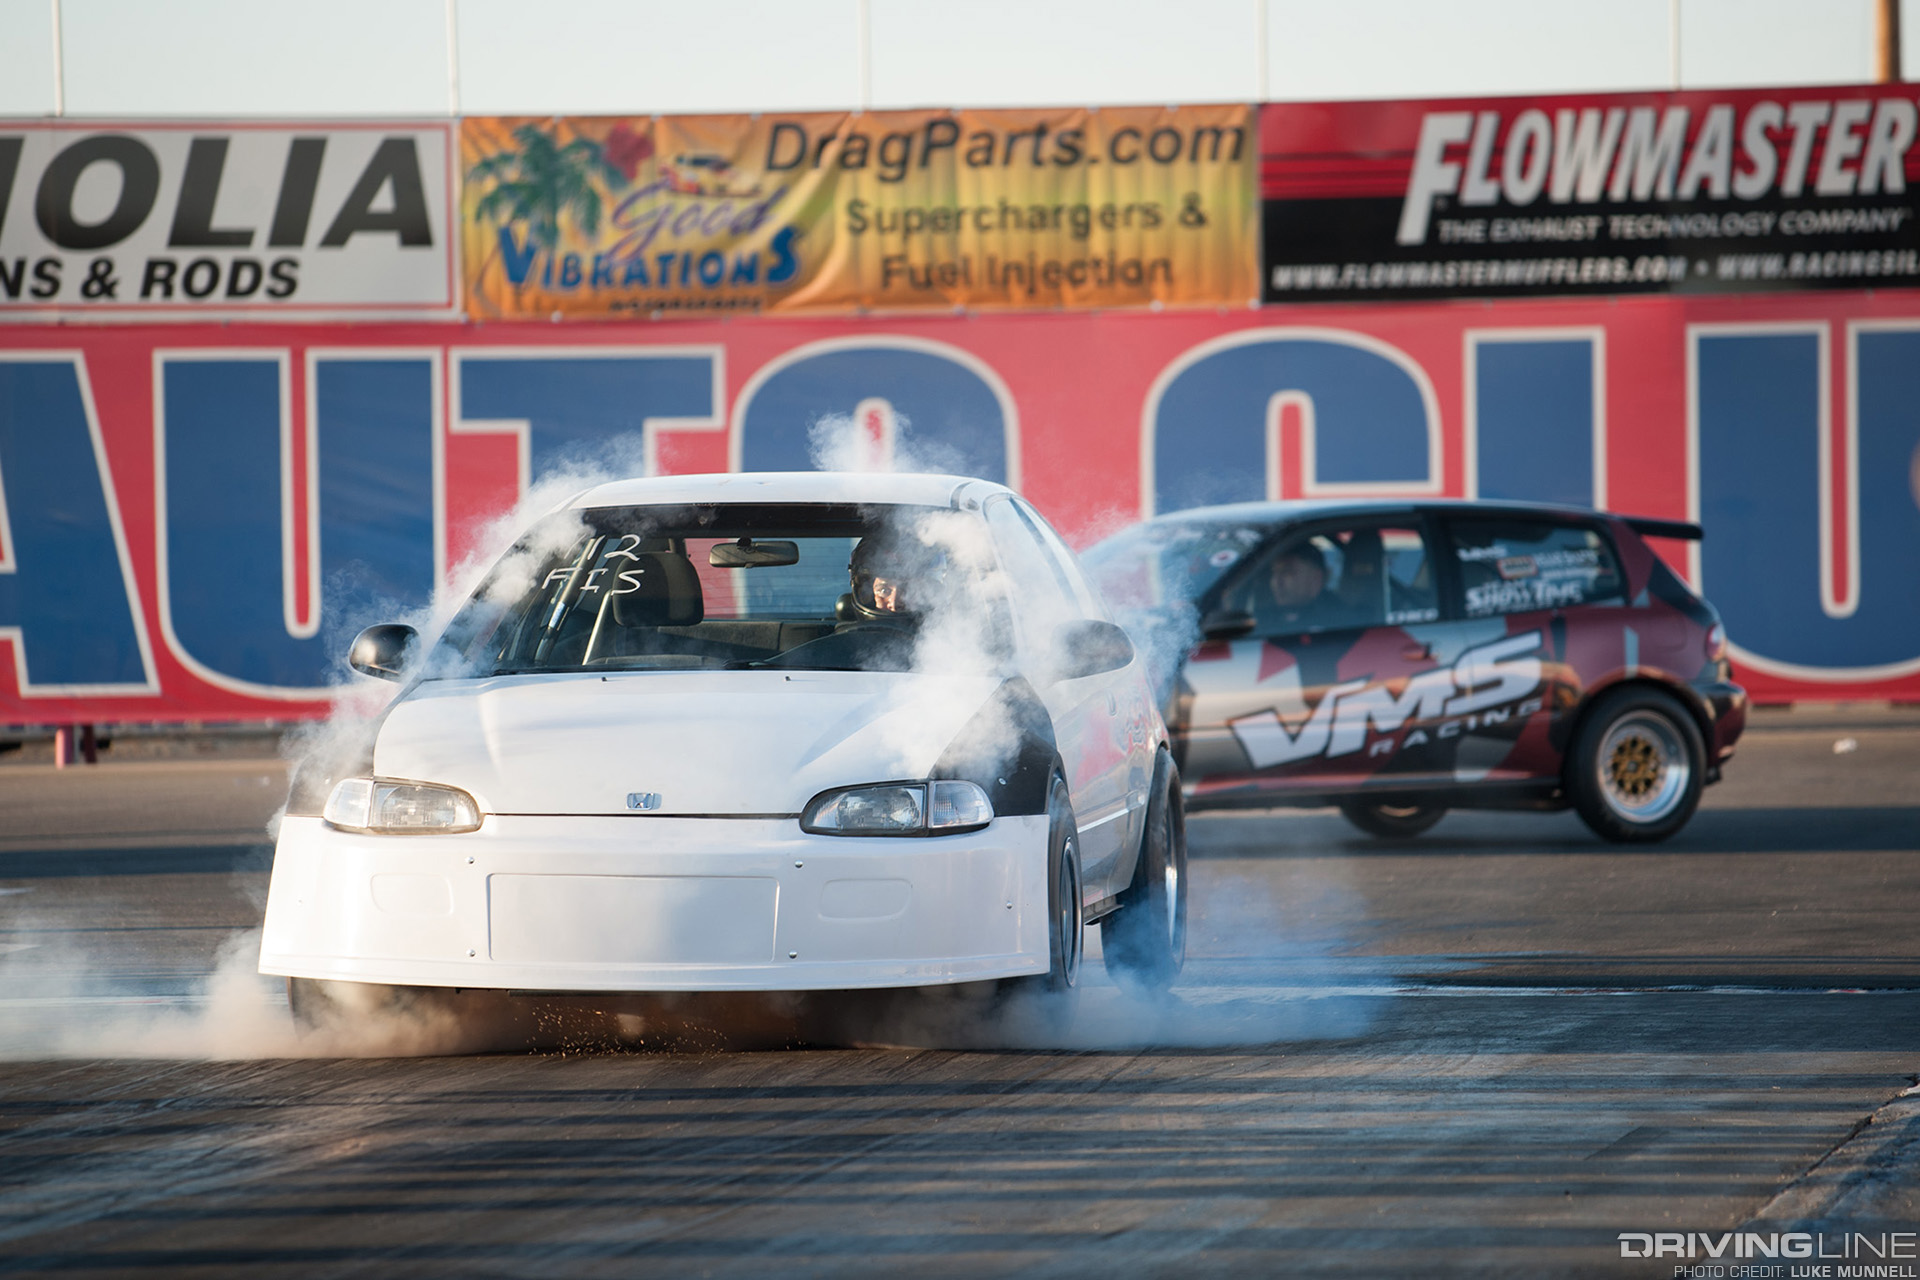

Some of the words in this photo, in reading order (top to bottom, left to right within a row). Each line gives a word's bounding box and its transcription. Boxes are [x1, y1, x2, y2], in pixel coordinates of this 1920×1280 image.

[765, 119, 1246, 183] DragParts.com
[1396, 97, 1918, 245] FLOWMASTER
[846, 197, 1163, 240] Superchargers
[1178, 191, 1209, 229] &
[1437, 217, 1488, 244] THE
[1490, 214, 1603, 243] EXHAUST
[1607, 208, 1776, 240] TECHNOLOGY
[81, 256, 121, 299] &
[139, 256, 301, 299] RODS
[881, 253, 971, 290] Fuel
[988, 250, 1174, 294] Injection
[1227, 628, 1543, 770] VMS
[1370, 699, 1543, 758] RACING
